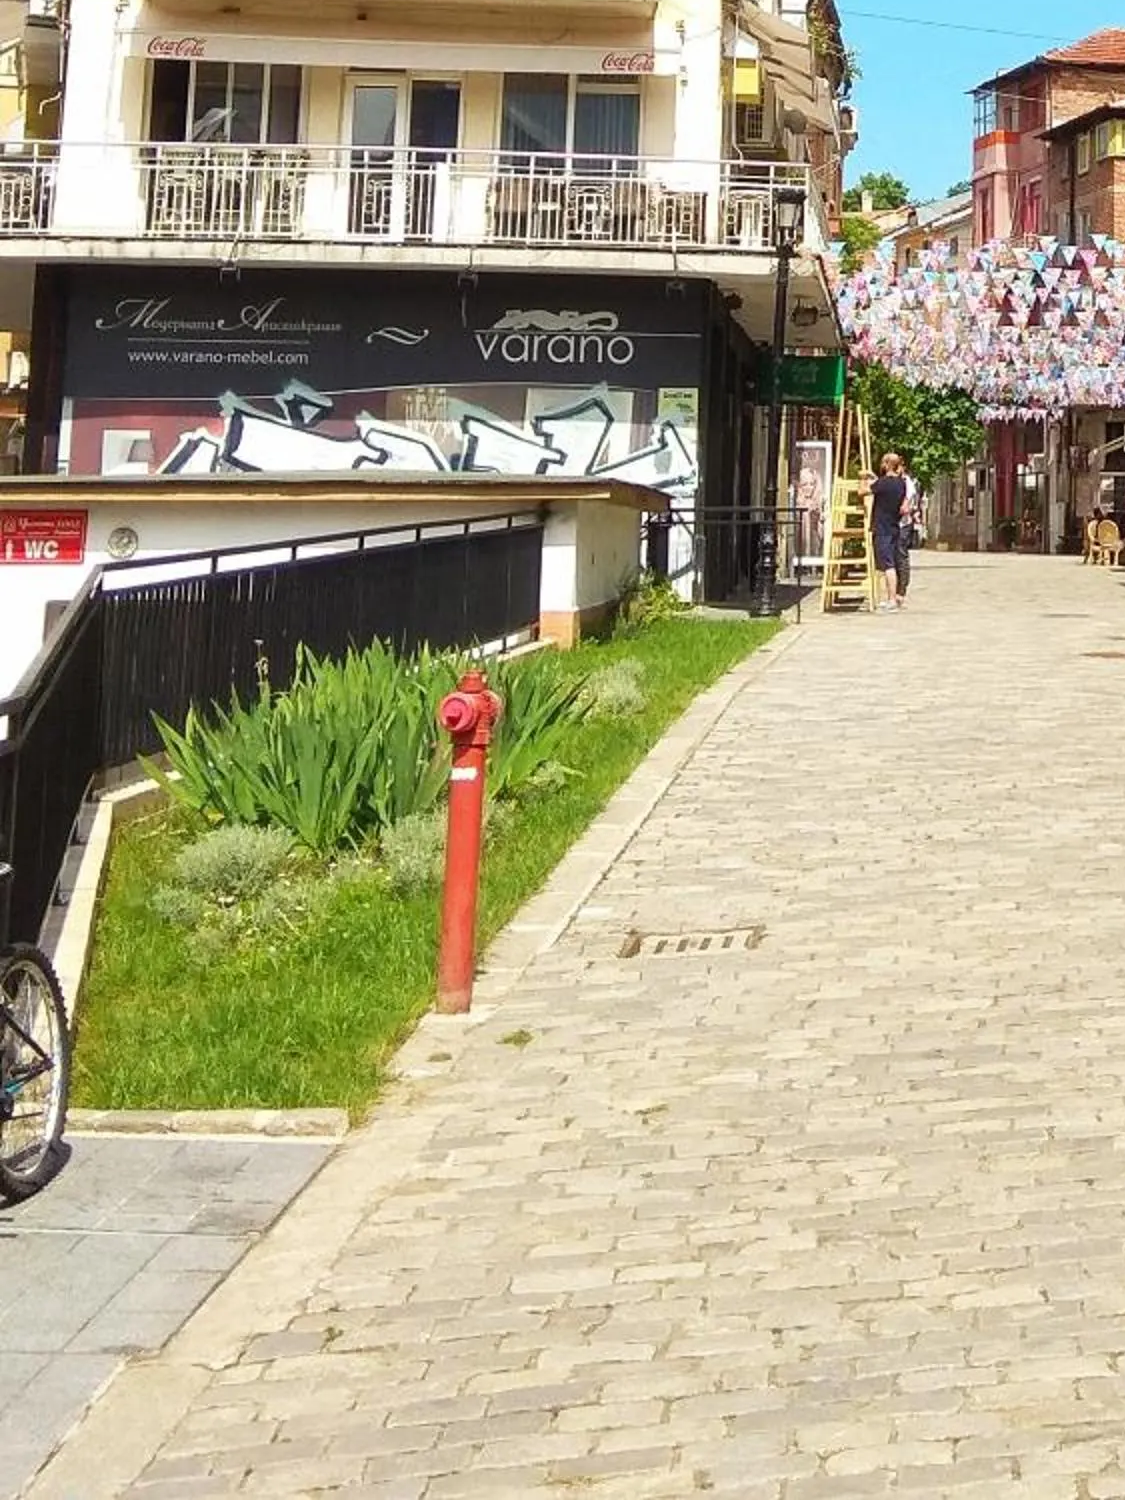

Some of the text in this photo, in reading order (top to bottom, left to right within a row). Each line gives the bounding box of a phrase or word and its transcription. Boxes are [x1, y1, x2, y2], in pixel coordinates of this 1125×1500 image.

[147, 35, 207, 56] Coca-Cola
[127, 350, 310, 366] www.varano-mebel.com
[475, 334, 634, 365] varano
[24, 539, 60, 560] WC
